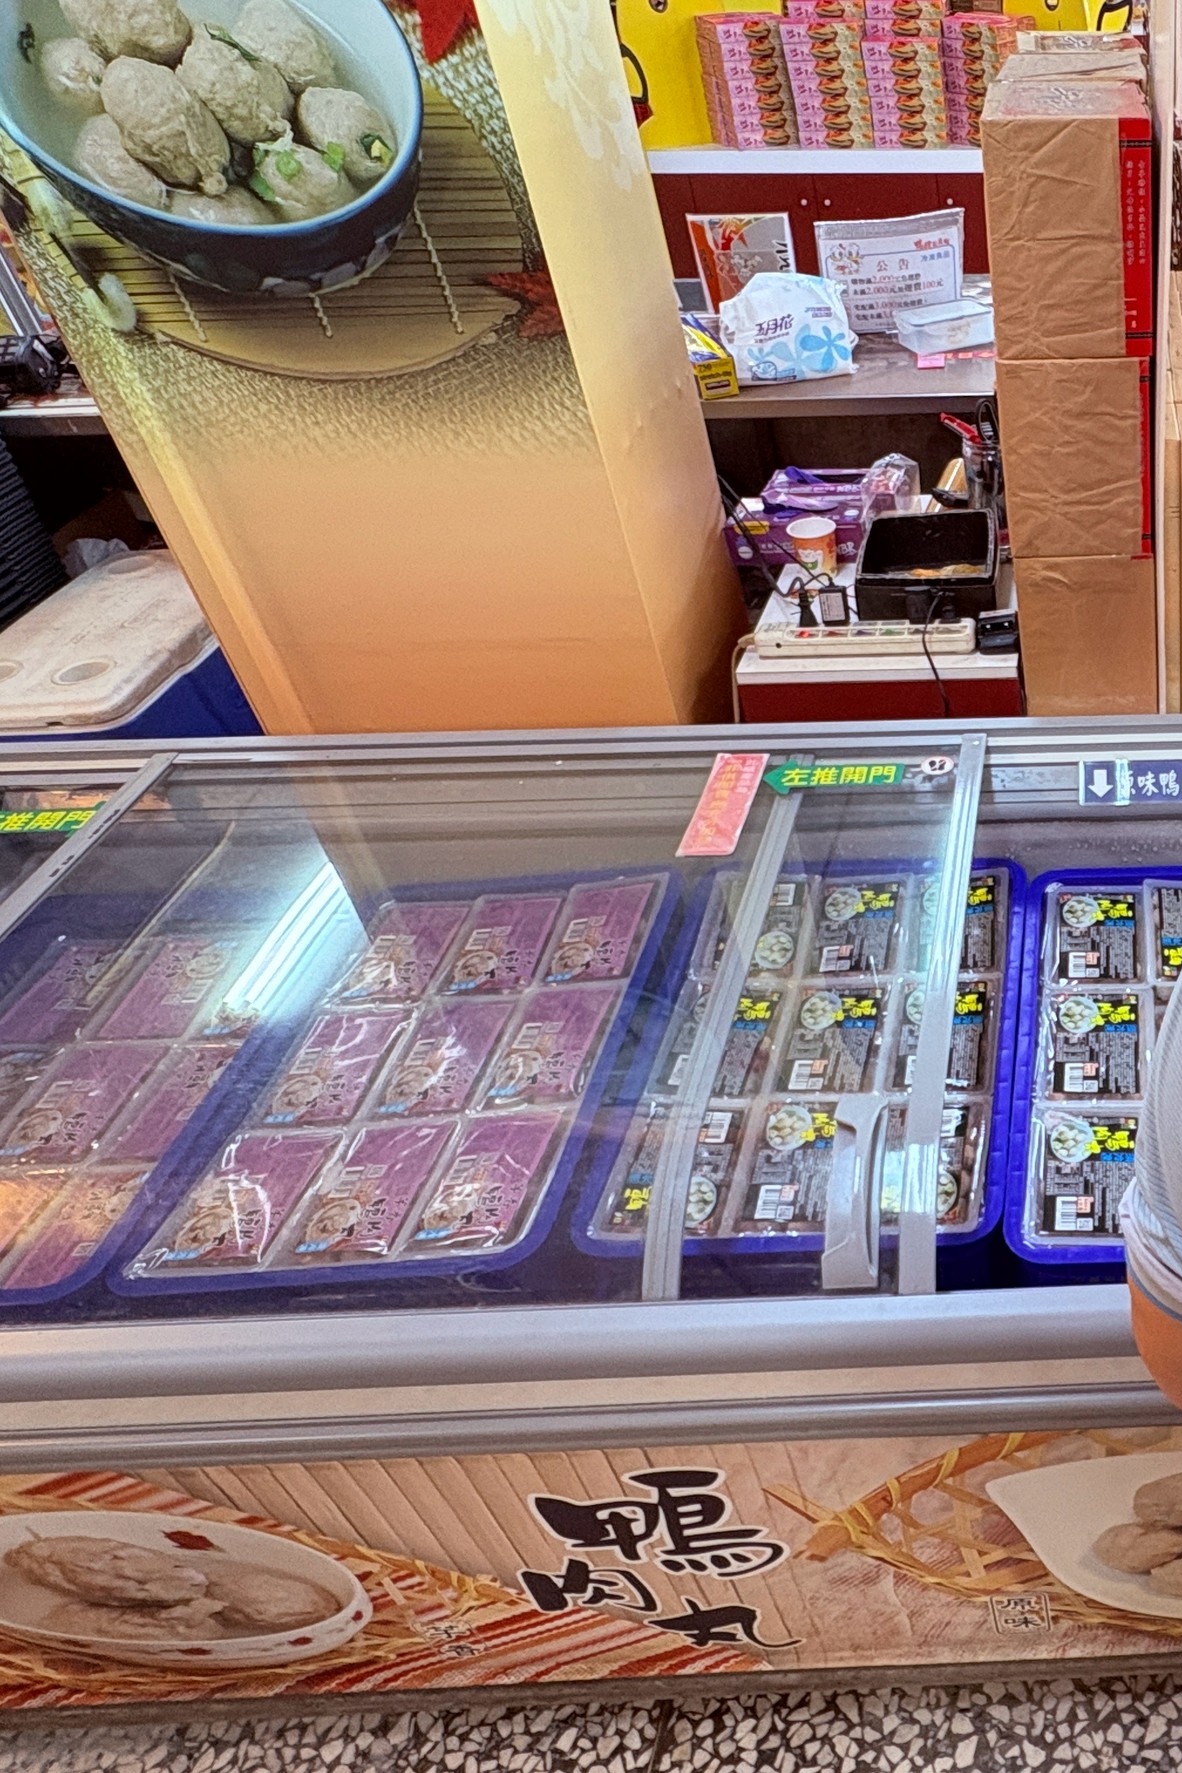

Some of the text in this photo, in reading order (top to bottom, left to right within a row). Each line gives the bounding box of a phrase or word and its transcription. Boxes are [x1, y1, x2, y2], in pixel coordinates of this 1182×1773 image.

[754, 313, 795, 337] 五月花
[781, 766, 897, 787] 左推開門
[0, 811, 97, 831] 推開門
[518, 1468, 804, 1650] 鴨肉丸
